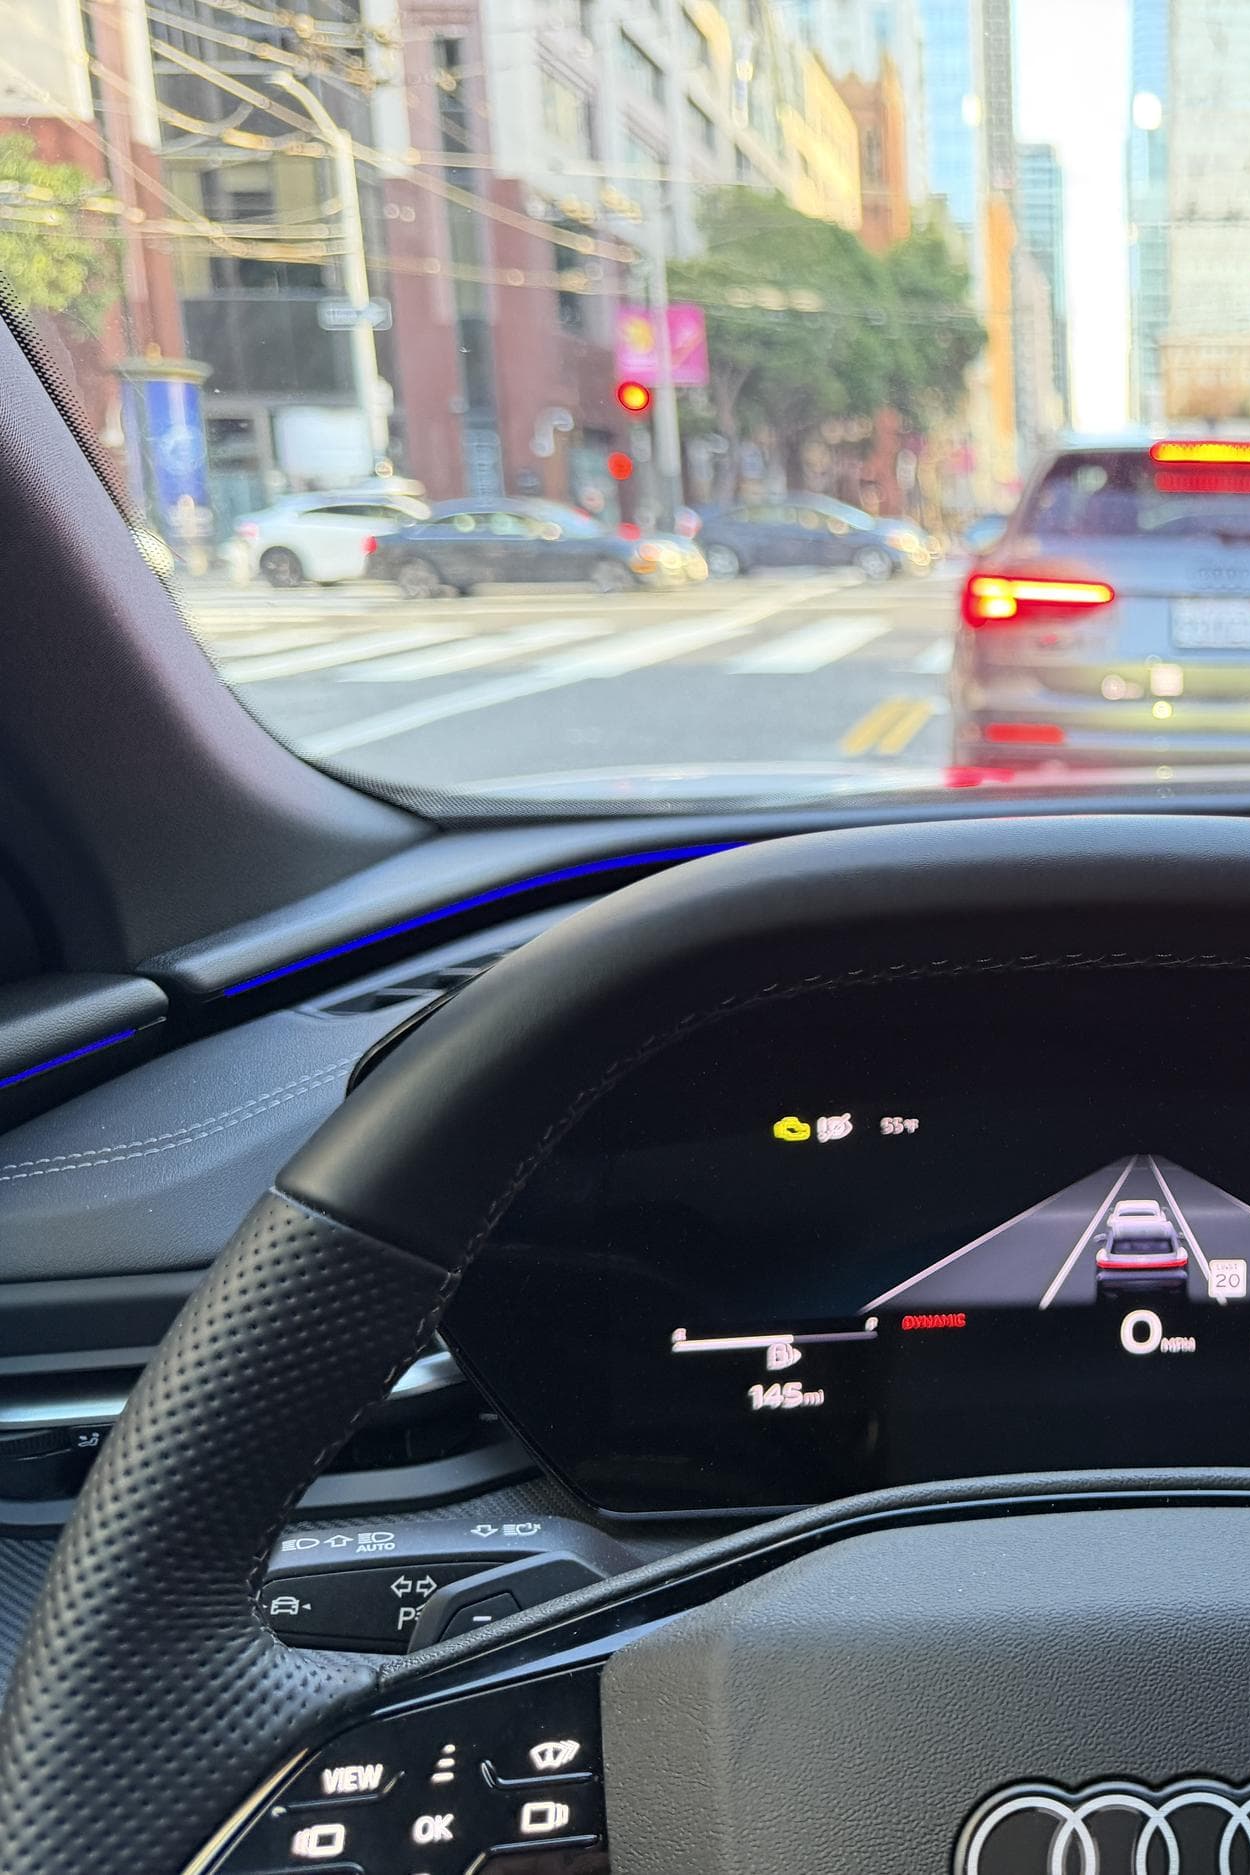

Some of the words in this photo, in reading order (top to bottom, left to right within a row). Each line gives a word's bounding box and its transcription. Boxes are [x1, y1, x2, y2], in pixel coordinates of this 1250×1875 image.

[1215, 1273, 1241, 1289] 20
[901, 1313, 966, 1331] DYNAMIC
[1120, 1309, 1163, 1354] 0
[748, 1381, 803, 1410] 145
[356, 1541, 396, 1553] AUTO
[322, 1763, 385, 1795] VIEW
[412, 1812, 456, 1844] OK
